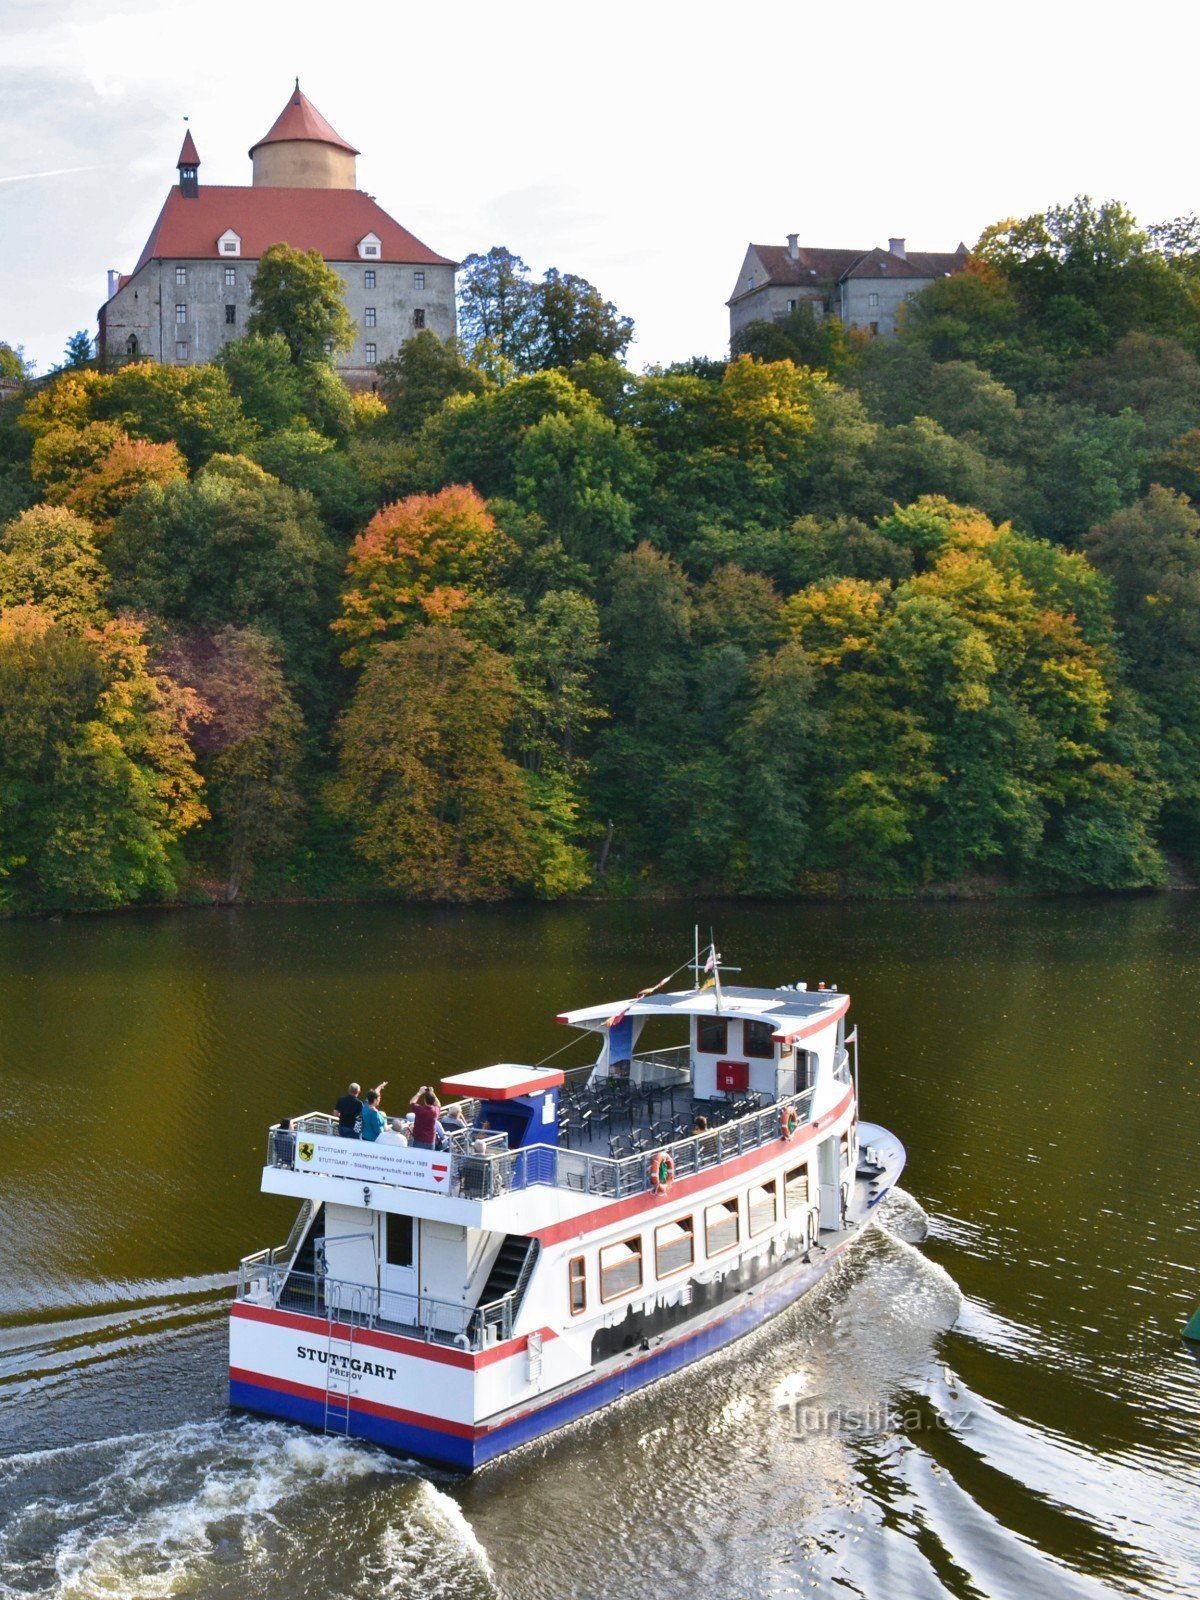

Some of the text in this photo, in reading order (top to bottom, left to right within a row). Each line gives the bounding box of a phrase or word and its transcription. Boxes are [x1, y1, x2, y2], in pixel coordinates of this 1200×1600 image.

[317, 1145, 348, 1155] STUTTGART
[318, 1156, 349, 1166] STUTTGART
[297, 1346, 397, 1381] STUTTGART
